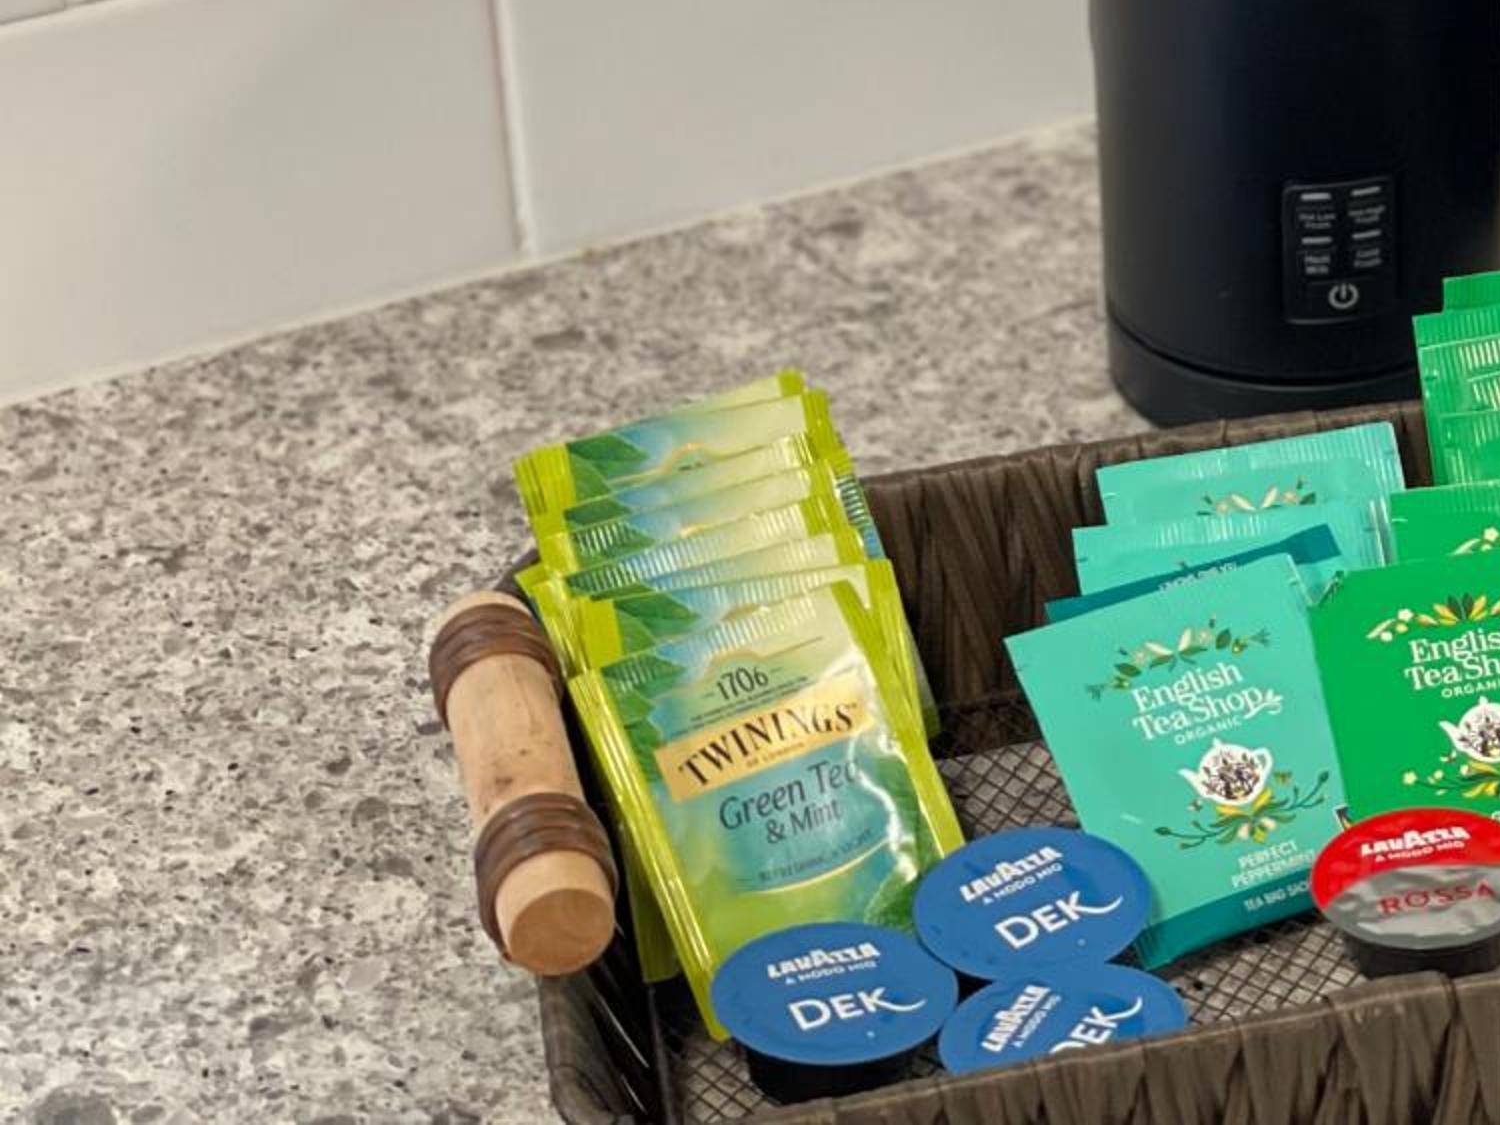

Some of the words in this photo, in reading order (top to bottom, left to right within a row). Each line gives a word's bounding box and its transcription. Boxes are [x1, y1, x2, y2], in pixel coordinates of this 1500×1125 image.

[716, 666, 770, 700] 1706
[1132, 661, 1244, 713] English
[677, 701, 853, 786] TWININGS
[1174, 715, 1242, 745] ORGANIC
[719, 779, 806, 831] Green
[766, 818, 786, 844] &
[789, 799, 843, 836] Mint
[1238, 839, 1298, 869] PERFECT
[1361, 825, 1471, 857] LAVAZZA
[960, 845, 1064, 903] LAVAZZA
[994, 889, 1124, 950] DEK
[1376, 880, 1498, 916] ROSSA
[767, 941, 881, 979] LAVAZZA
[787, 986, 928, 1031] DEK
[980, 984, 1052, 1052] LAVAZZA
